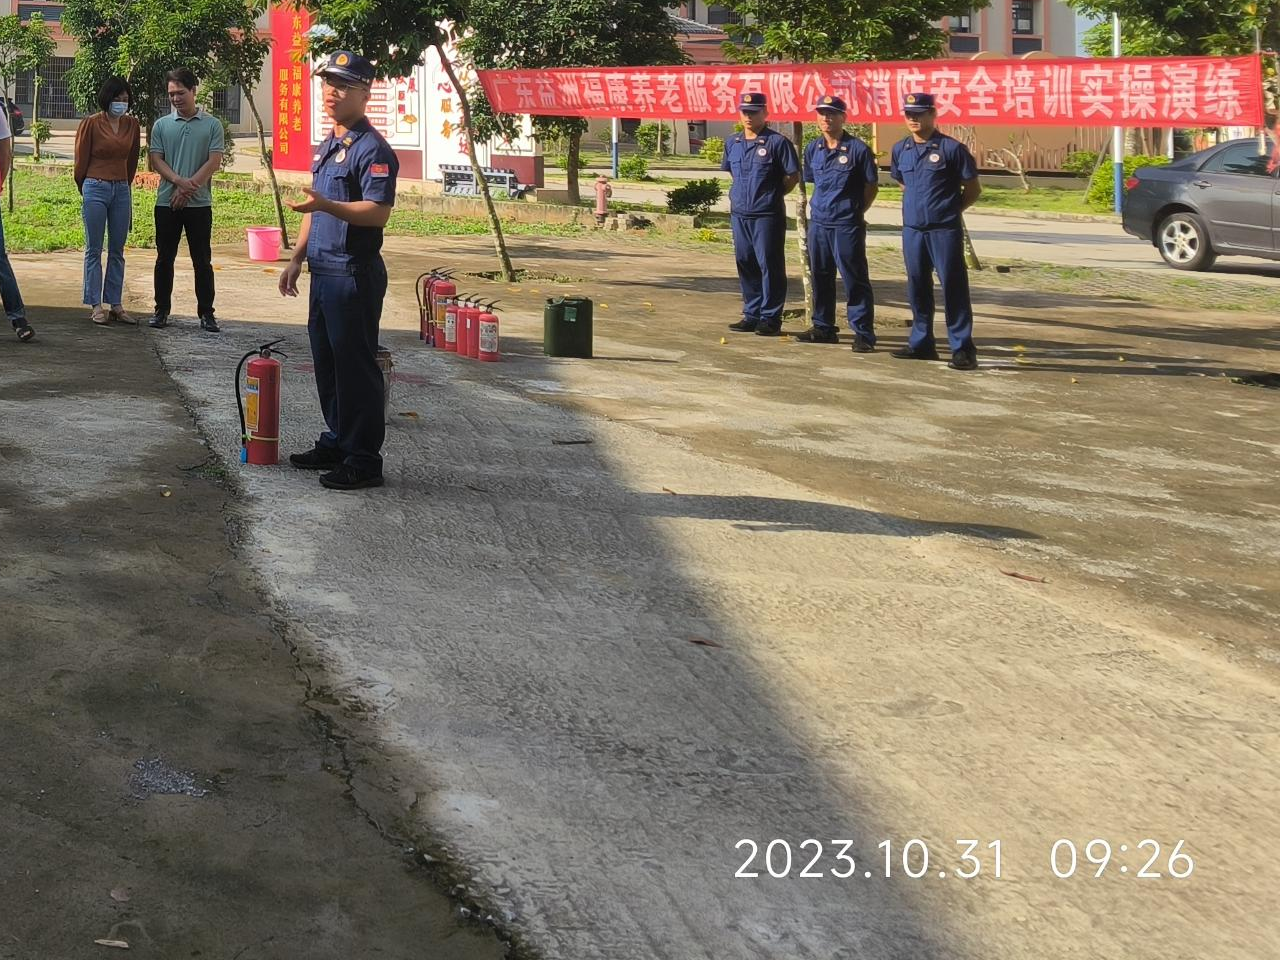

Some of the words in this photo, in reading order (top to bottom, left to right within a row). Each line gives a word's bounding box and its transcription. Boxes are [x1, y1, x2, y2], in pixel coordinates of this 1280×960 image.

[279, 68, 289, 155] 服务有限公司
